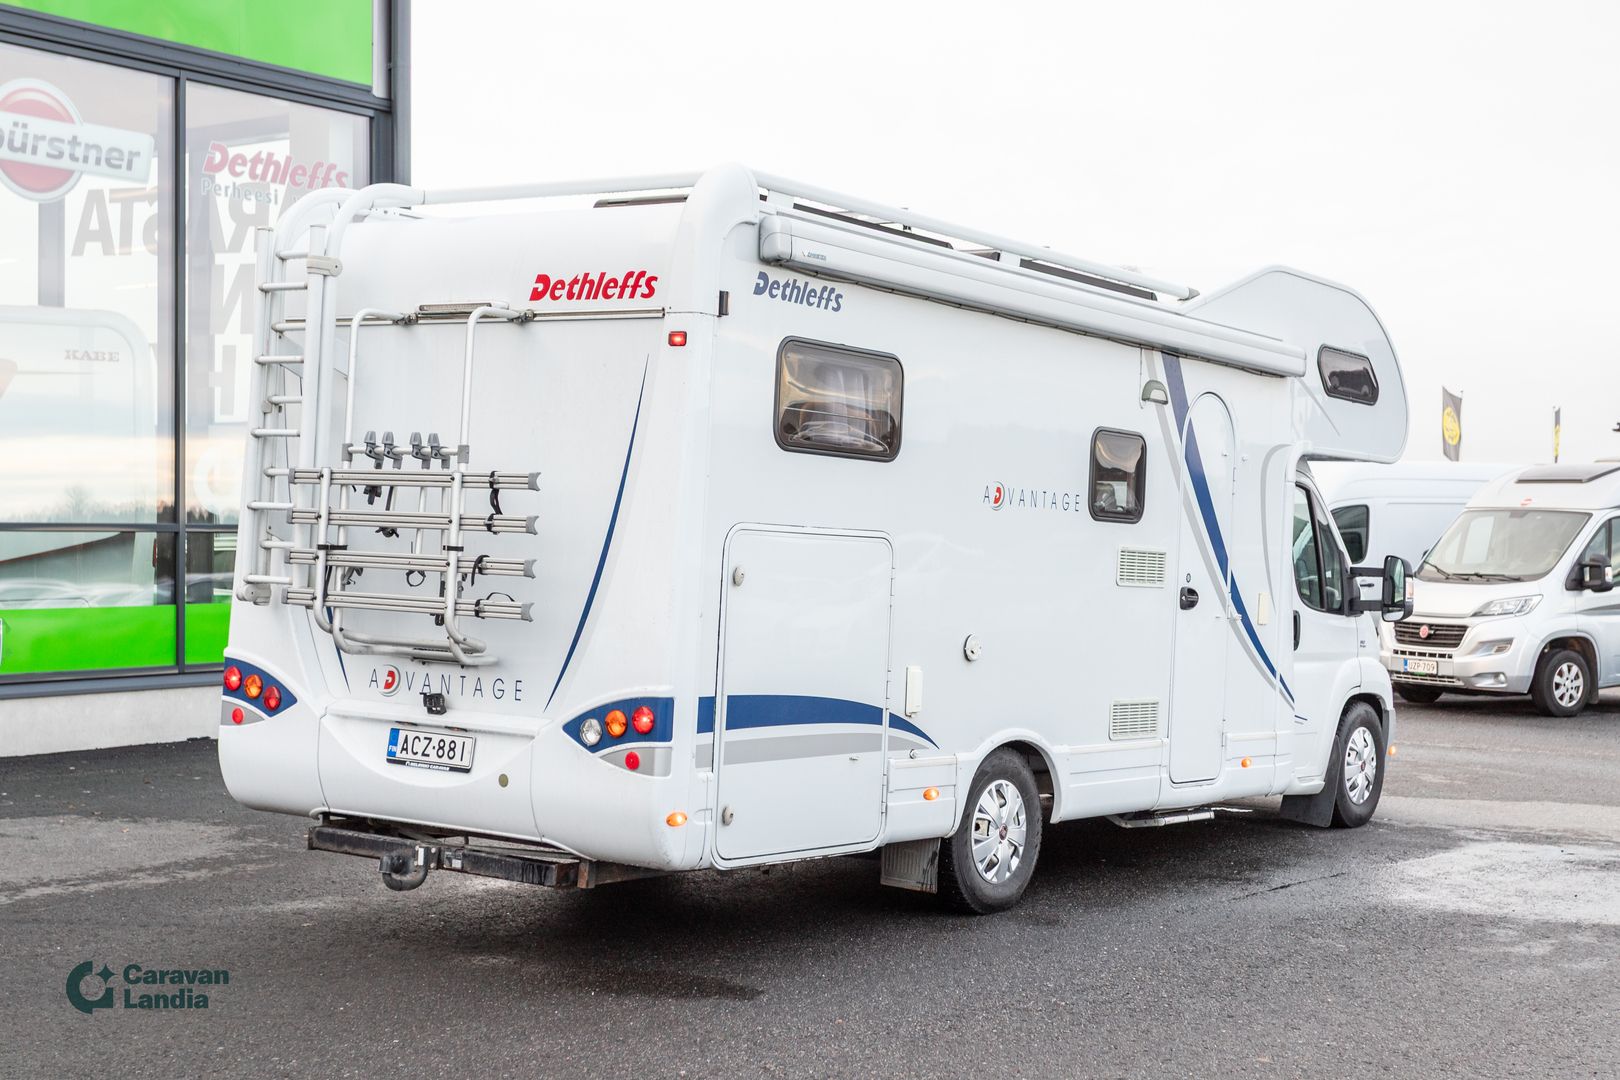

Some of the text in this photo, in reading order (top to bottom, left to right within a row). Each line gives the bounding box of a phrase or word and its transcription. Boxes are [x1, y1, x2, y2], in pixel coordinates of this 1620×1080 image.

[201, 177, 279, 206] Perheesi
[529, 270, 659, 301] Dethleffs
[753, 271, 843, 312] Dethleffs
[64, 349, 120, 362] KABE
[983, 481, 1080, 512] ADVANTAGE
[368, 664, 523, 701] ADVANTAGE
[400, 734, 466, 762] ACZ-881
